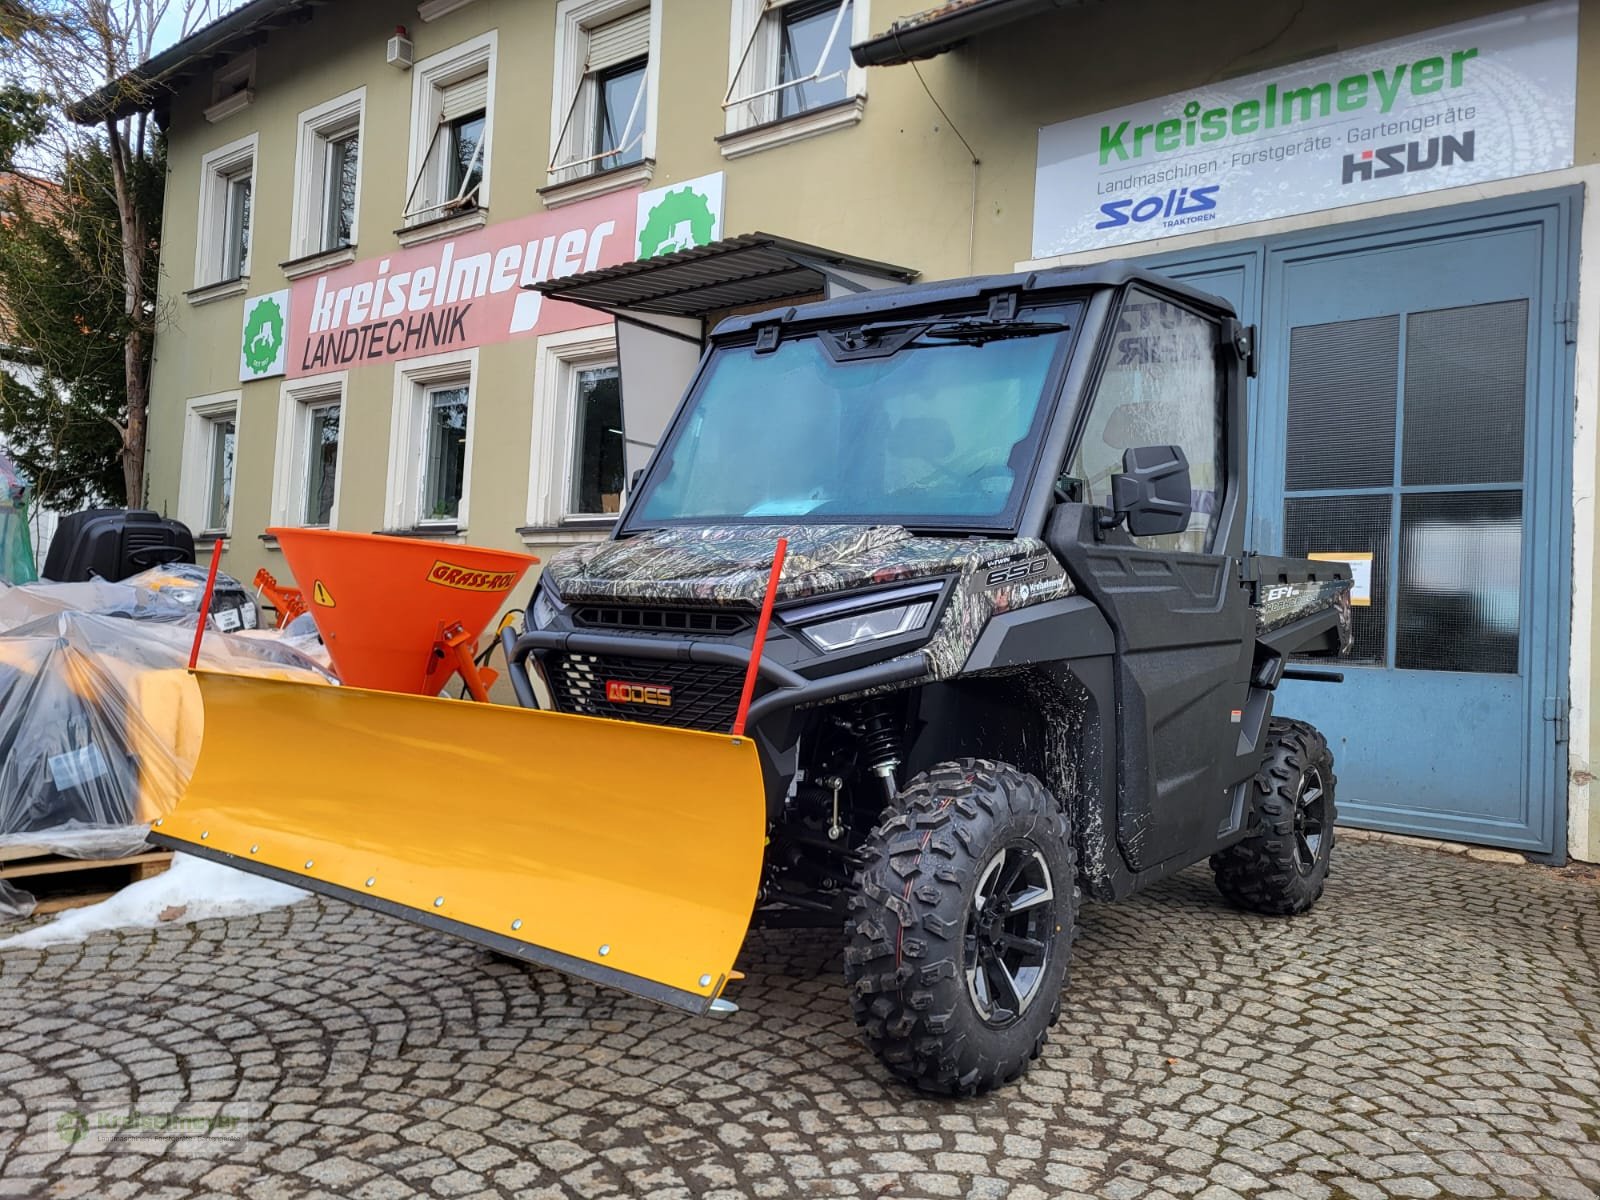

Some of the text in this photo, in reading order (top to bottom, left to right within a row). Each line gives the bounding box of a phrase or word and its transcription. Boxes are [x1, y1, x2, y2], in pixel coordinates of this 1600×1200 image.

[1099, 48, 1479, 165] Kreiselmeyer
[1097, 106, 1476, 195] Landmaschinen Forstgeräte Gartengeräte
[1163, 213, 1216, 229] TRAKTOREN
[309, 220, 616, 334] kreiselmeyer
[302, 303, 470, 370] LANDTECHNIK
[985, 558, 1049, 586] 650
[1267, 586, 1293, 601] EFI
[609, 683, 671, 706] AODES
